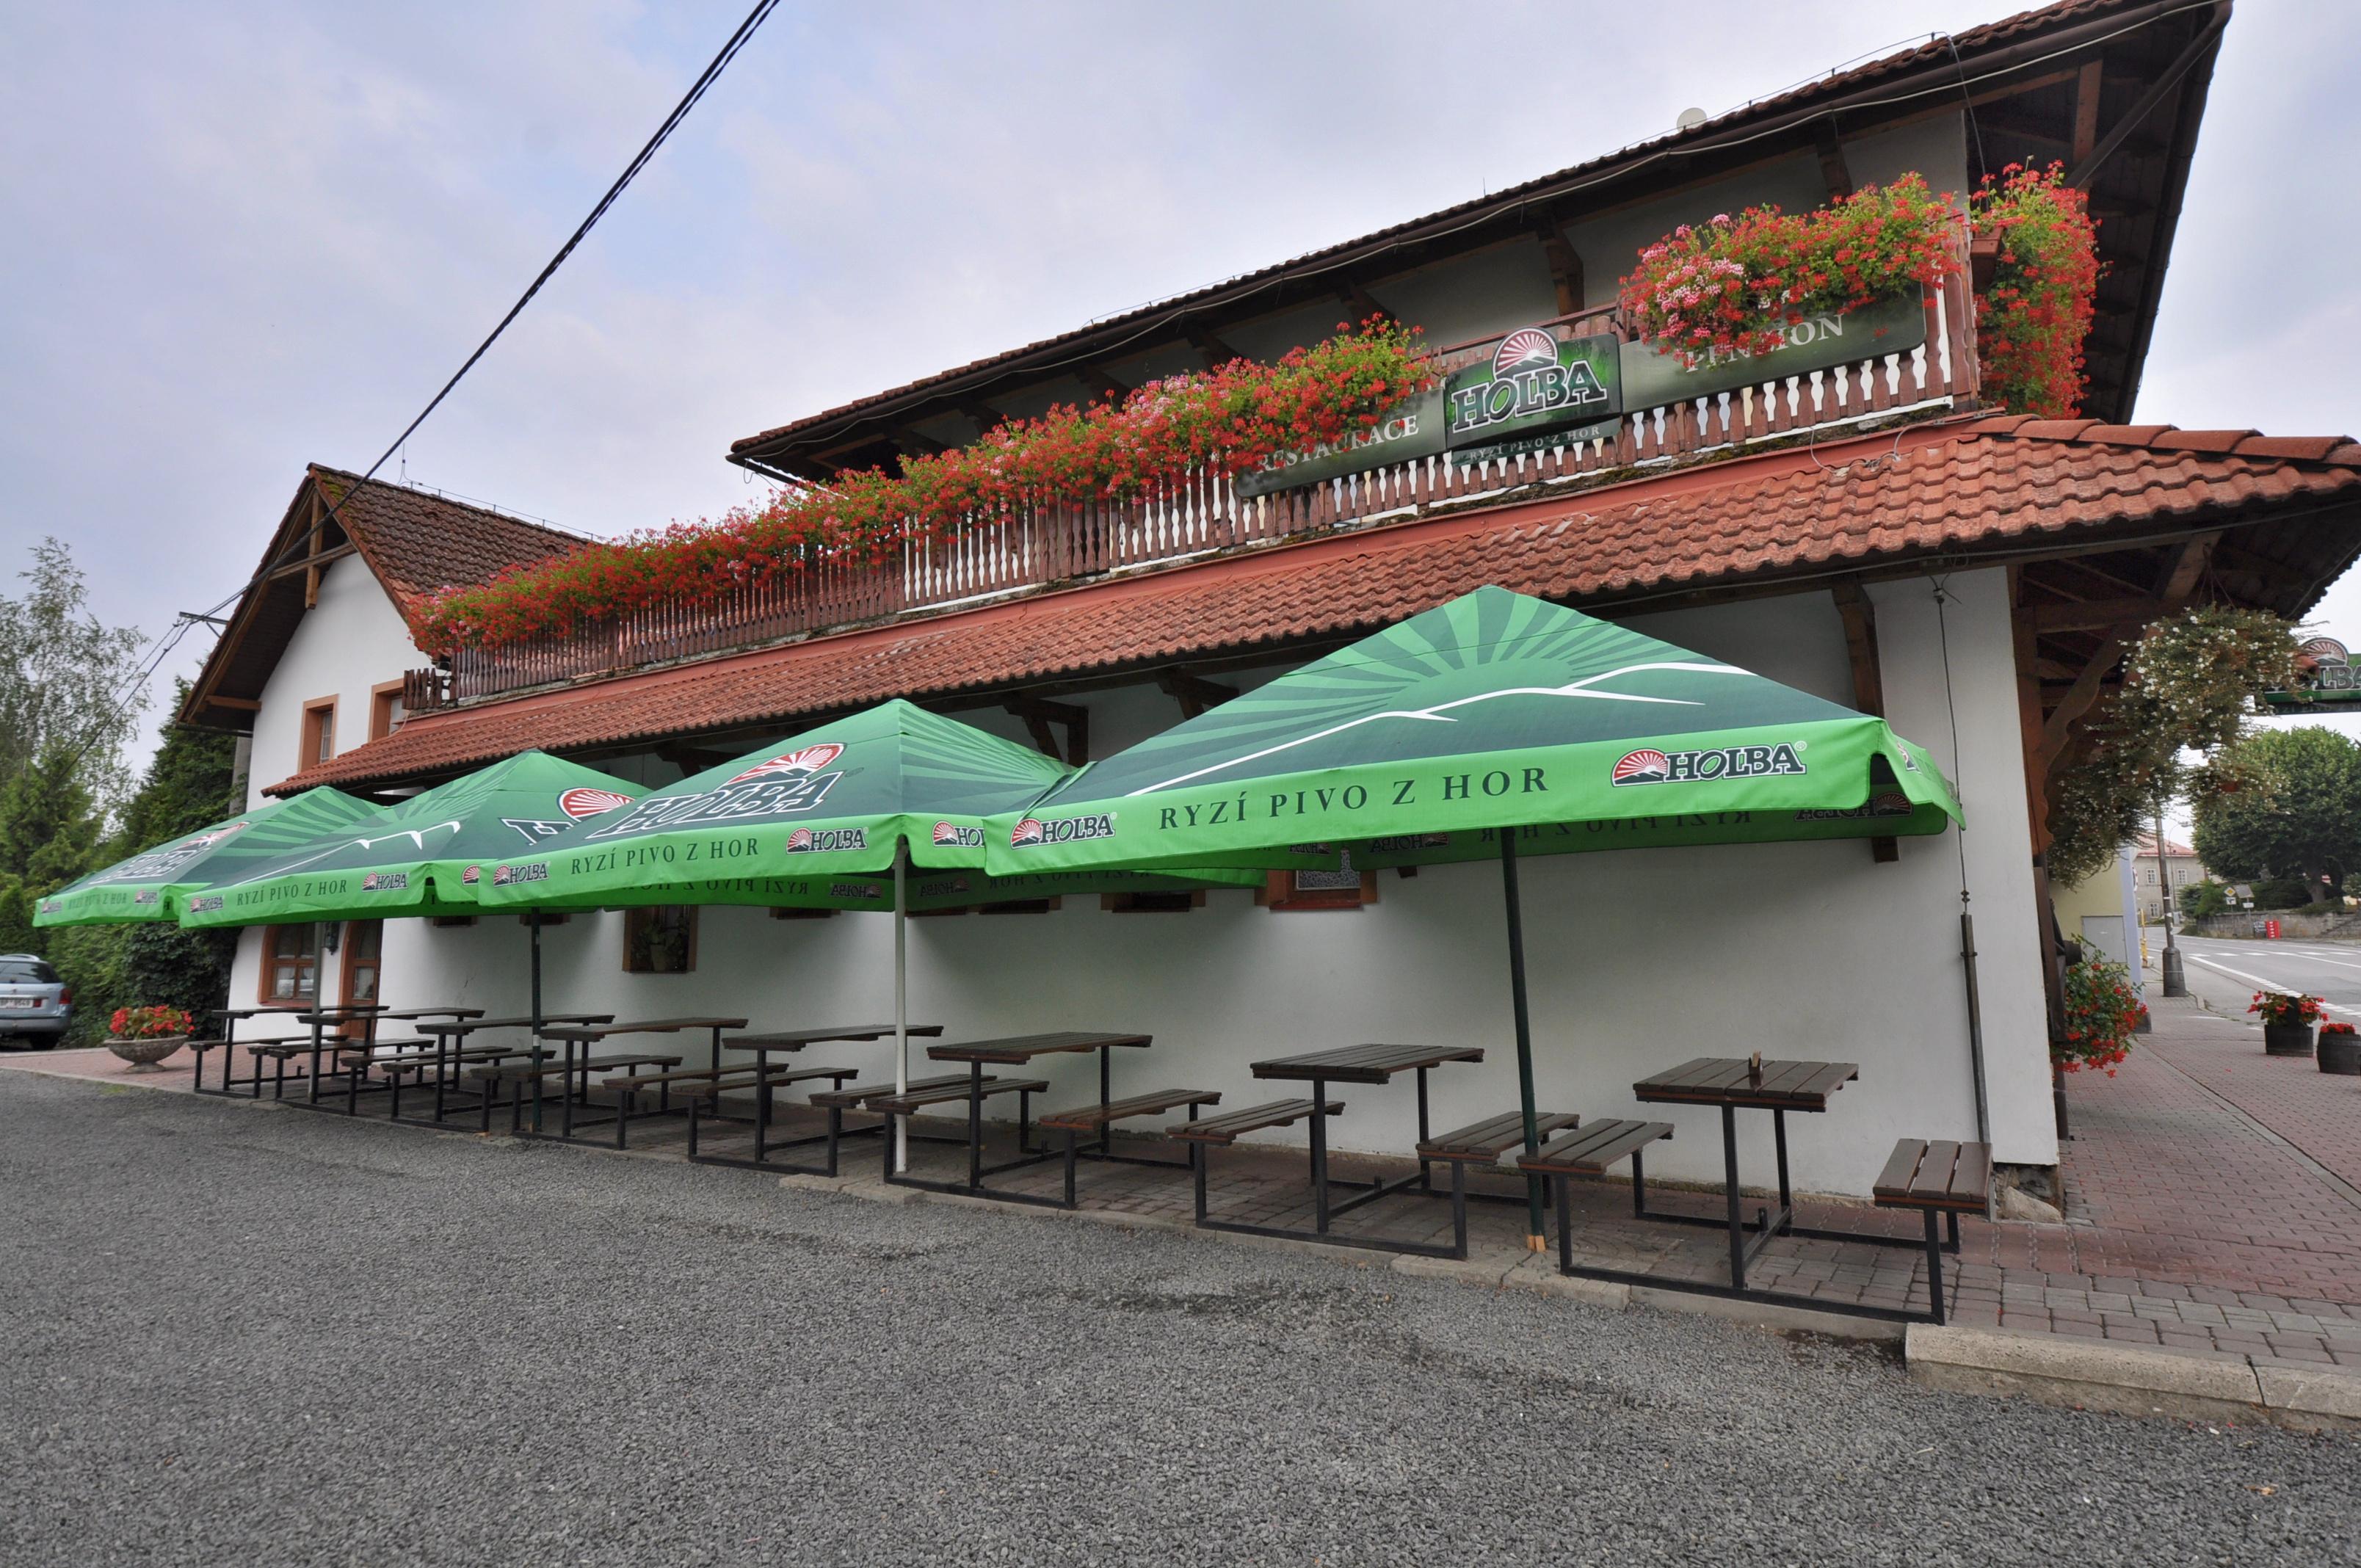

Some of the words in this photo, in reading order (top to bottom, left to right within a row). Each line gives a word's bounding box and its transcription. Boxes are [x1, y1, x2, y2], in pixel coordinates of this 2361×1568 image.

[1686, 313, 1845, 373] PENION
[1451, 360, 1608, 433] HOLBA
[1567, 426, 1600, 440] HOR
[1664, 743, 1807, 780] HOLBA
[584, 770, 846, 839] HOLBA
[1158, 791, 1247, 830] RYZÍ
[1269, 785, 1368, 818] PIVO
[1392, 780, 1415, 805] Z
[1442, 767, 1549, 800] HOR
[809, 828, 868, 852] HOLBA
[954, 827, 985, 848] HOL
[1039, 813, 1117, 845] HOLBA
[571, 847, 617, 875] RYZÍ
[625, 845, 675, 867] PIVO
[686, 843, 698, 860] Z
[710, 838, 758, 859] HOR
[377, 874, 409, 890] HOLBA
[509, 863, 549, 884] HOLBA
[237, 885, 264, 906] RYZÍ
[270, 884, 299, 901] PIVO
[304, 885, 312, 897] Z
[319, 879, 347, 896] HOR
